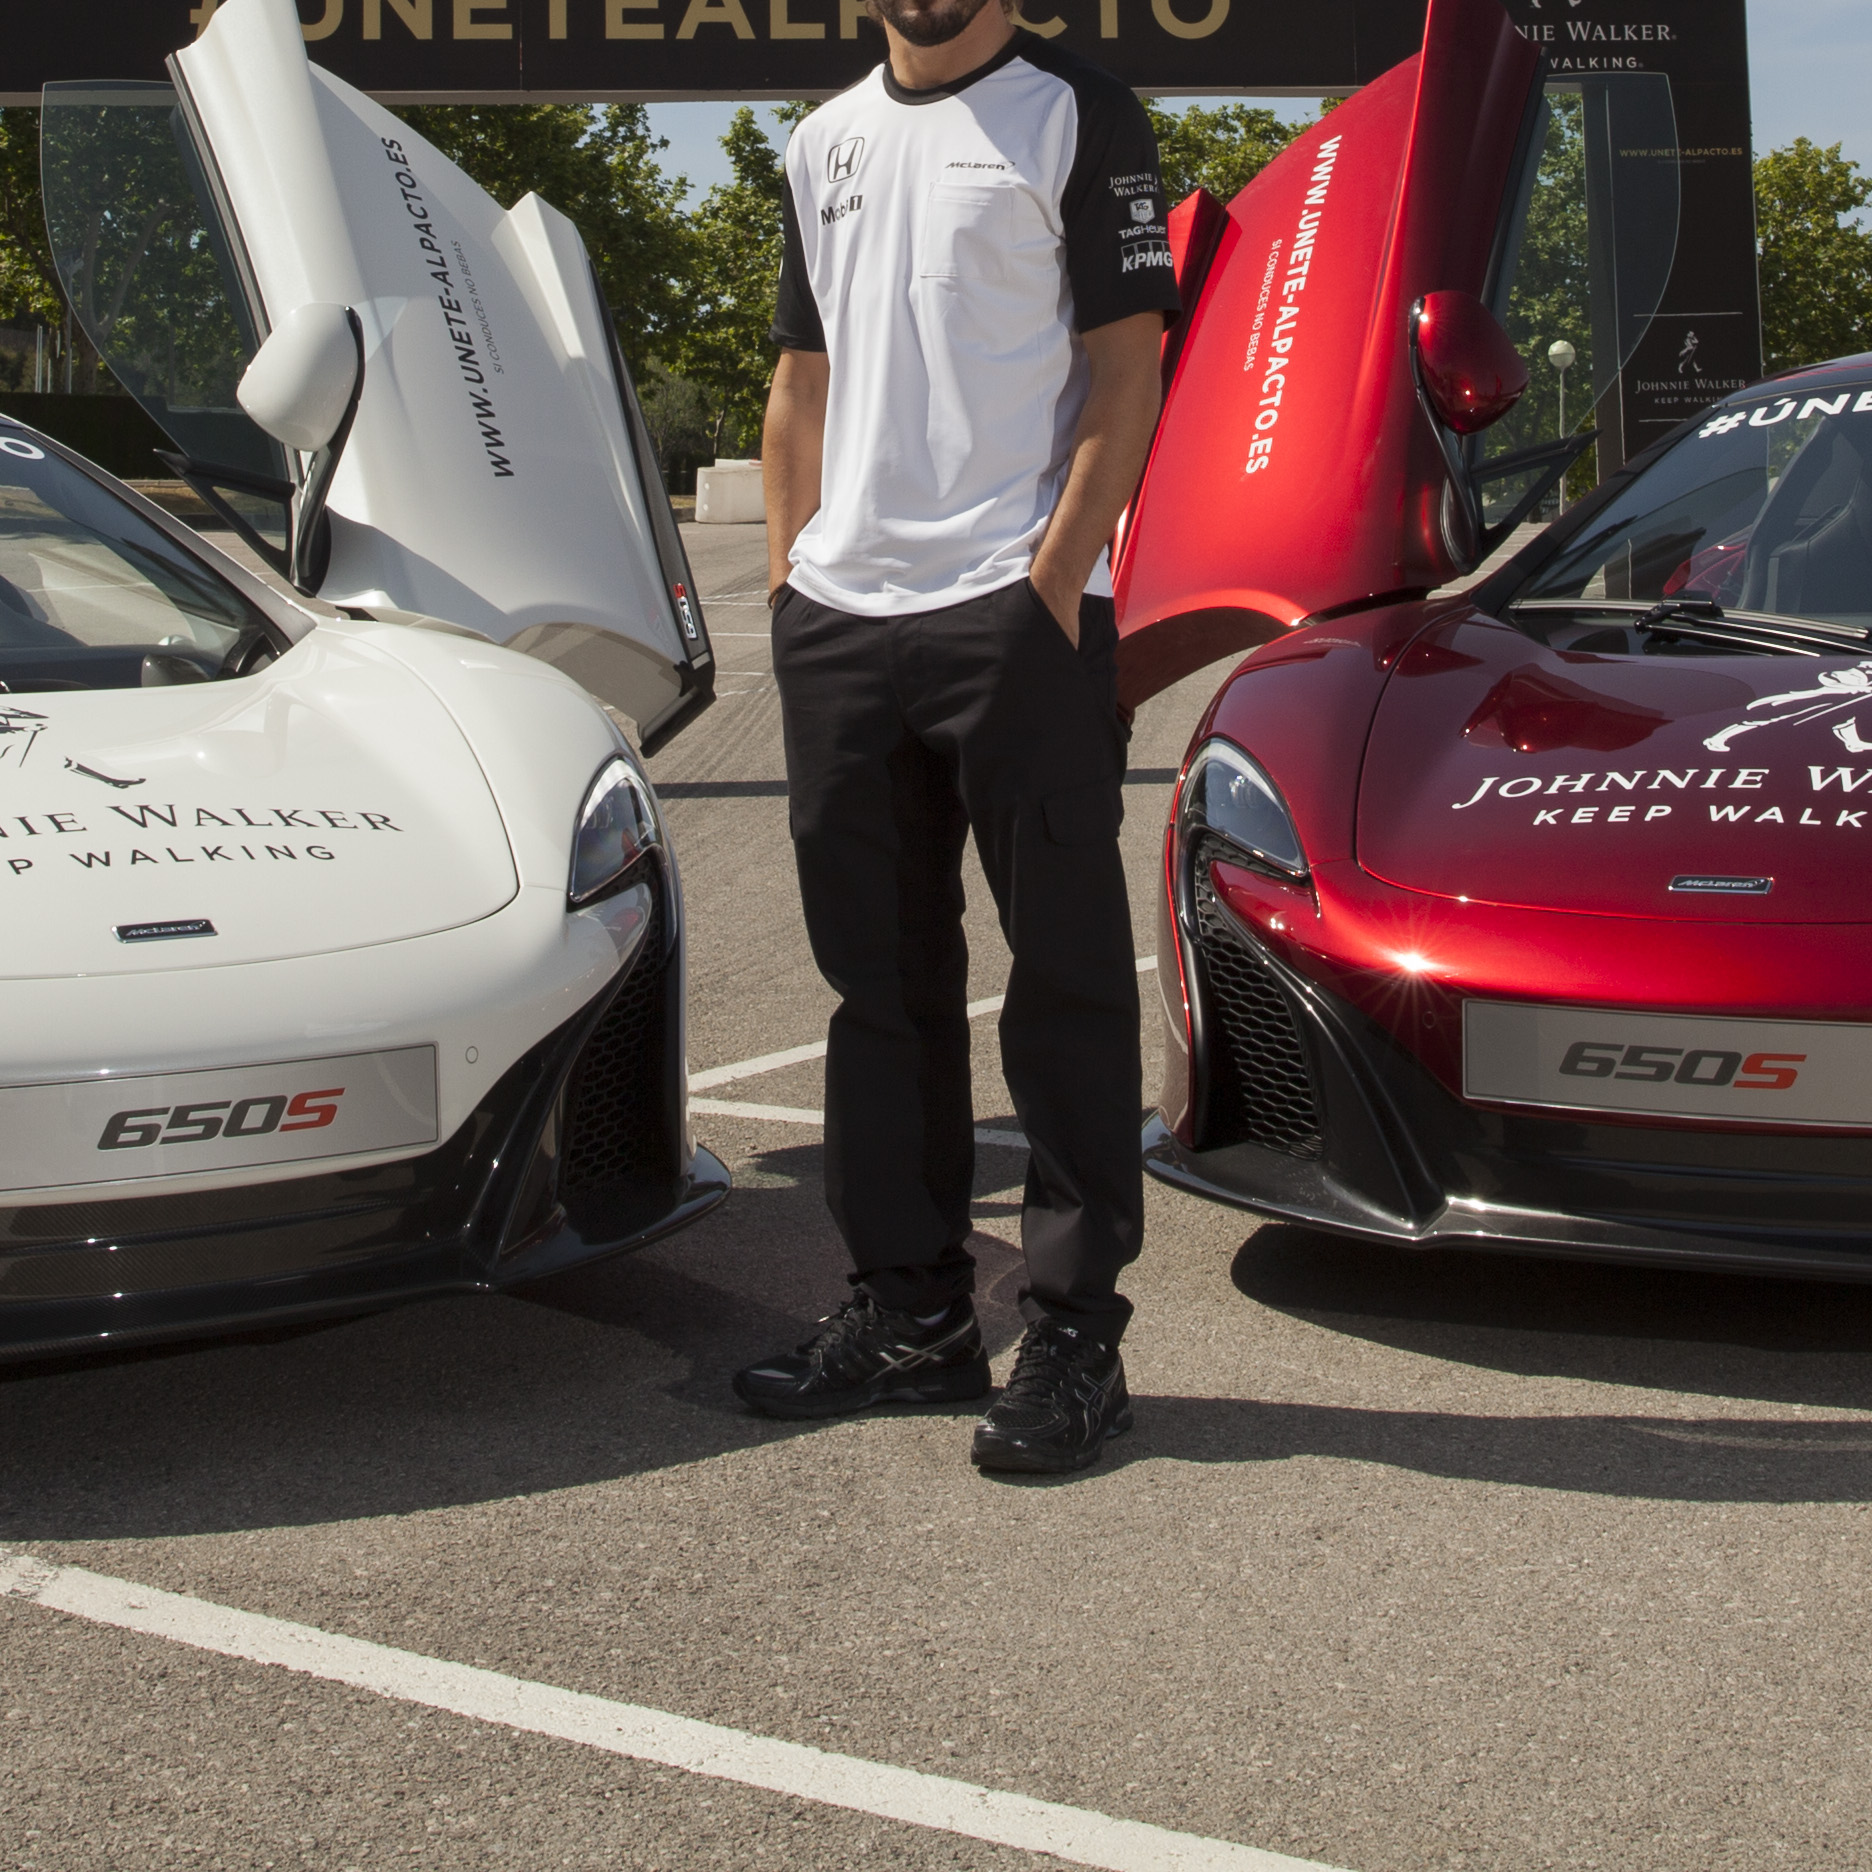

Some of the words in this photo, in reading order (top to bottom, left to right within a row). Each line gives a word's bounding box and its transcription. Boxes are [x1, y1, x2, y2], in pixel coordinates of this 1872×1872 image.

[1567, 21, 1670, 41] WALKER
[945, 161, 1006, 171] McLaren
[1109, 173, 1153, 189] JOHNNIE
[451, 240, 471, 276] BEBAS
[1122, 250, 1173, 273] KPMG
[465, 278, 478, 296] NO
[1257, 251, 1279, 311] CONDUCES
[381, 136, 515, 479] WWW.UNETE-ALPACTO.ES
[1246, 135, 1342, 474] WWW.UNETE-ALPACTO.ES
[472, 296, 500, 361] CONDUCES
[1252, 313, 1264, 330] NO
[1243, 332, 1260, 371] BEBAS
[1635, 380, 1690, 394] JOHNNIE
[1452, 768, 1770, 810] JOHNNIE
[105, 803, 405, 832] WALKER
[1532, 805, 1673, 826] KEEP
[69, 844, 336, 869] WALKING
[1559, 1041, 1807, 1090] 650S
[97, 1088, 345, 1151] 650S
